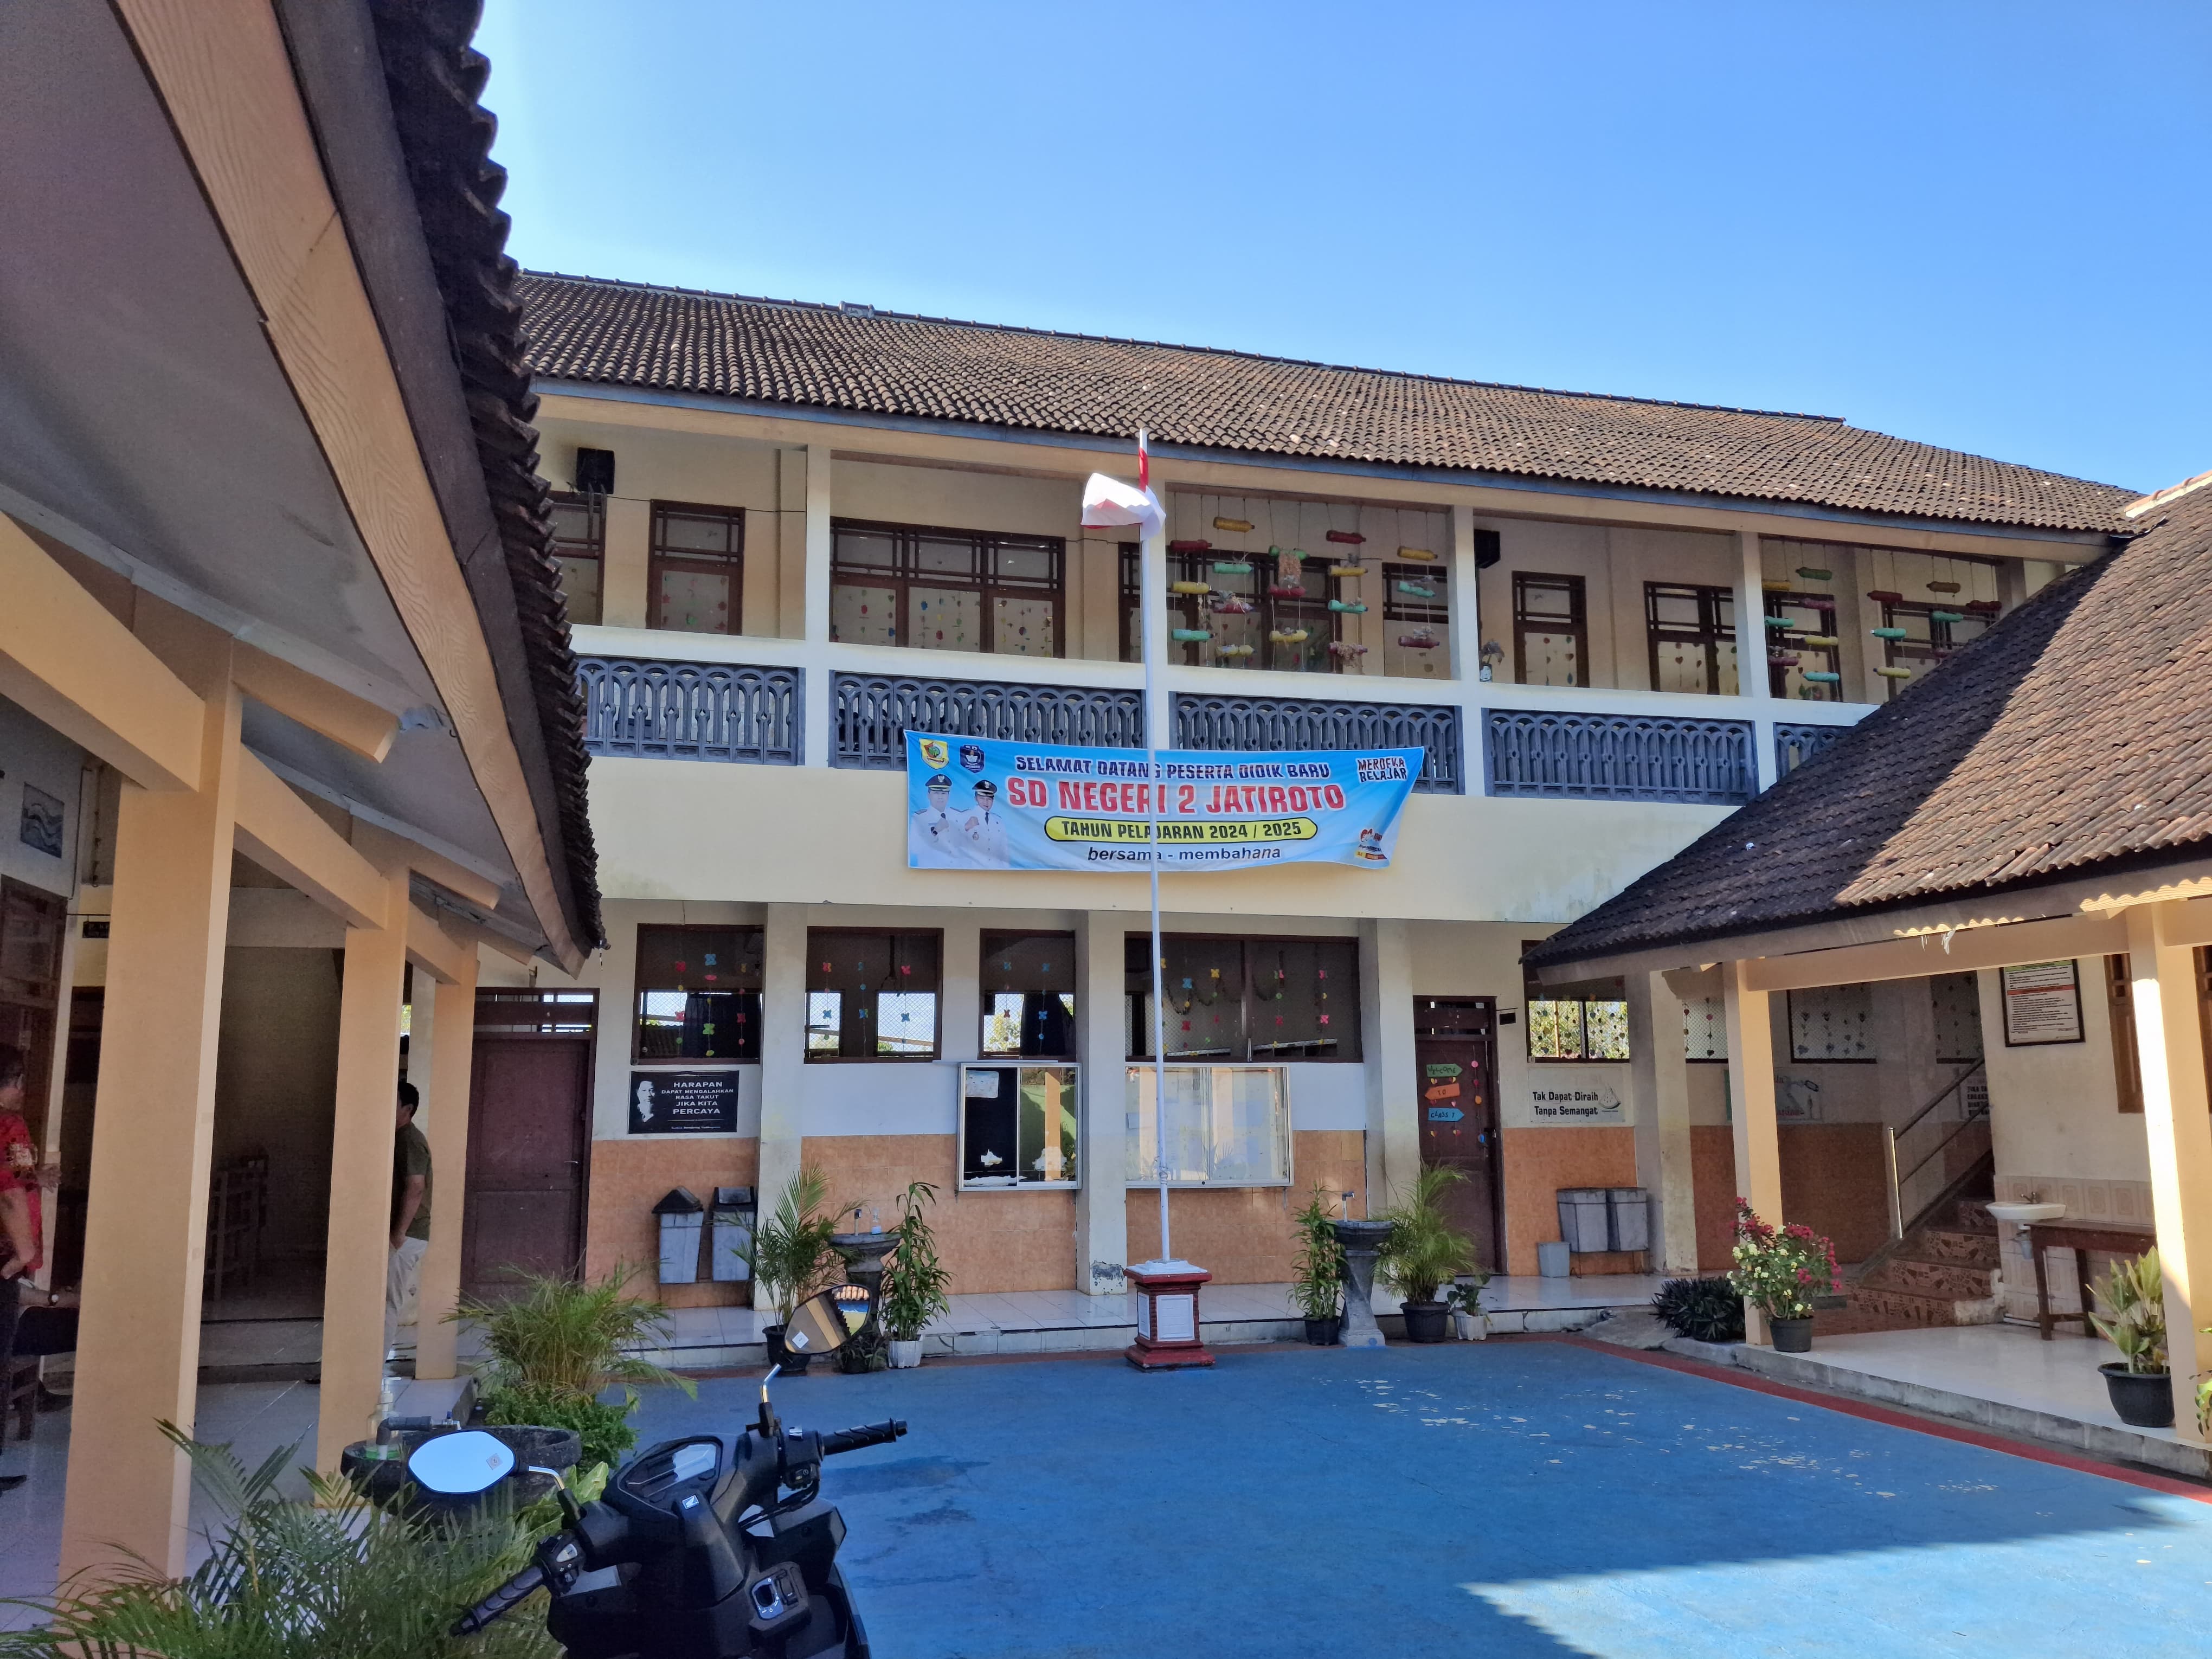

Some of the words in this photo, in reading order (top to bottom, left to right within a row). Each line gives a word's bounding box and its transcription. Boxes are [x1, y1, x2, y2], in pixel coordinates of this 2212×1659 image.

[1016, 757, 1092, 774] SELAMAT
[1167, 763, 1234, 779] PESERTA
[1239, 764, 1283, 779] DIDIK
[1287, 764, 1329, 777] BARU
[1359, 768, 1407, 782] BELAJAR
[1007, 777, 1047, 807] SD
[1058, 781, 1166, 813] NEGERI
[1178, 785, 1195, 813] 2
[1205, 785, 1344, 813] JATIROTO
[1061, 821, 1112, 838] TAHUN
[1117, 824, 1204, 839] PELAJARAN
[1209, 825, 1248, 839] 2024
[1253, 824, 1257, 839] /
[1263, 821, 1302, 837] 2025
[1179, 847, 1281, 860] membahana
[1532, 1091, 1546, 1101] Tak
[1548, 1091, 1572, 1102] Dapat
[1574, 1091, 1598, 1101] Diraih
[1534, 1105, 1557, 1117] Tanpa
[1559, 1105, 1598, 1117] Semangat
